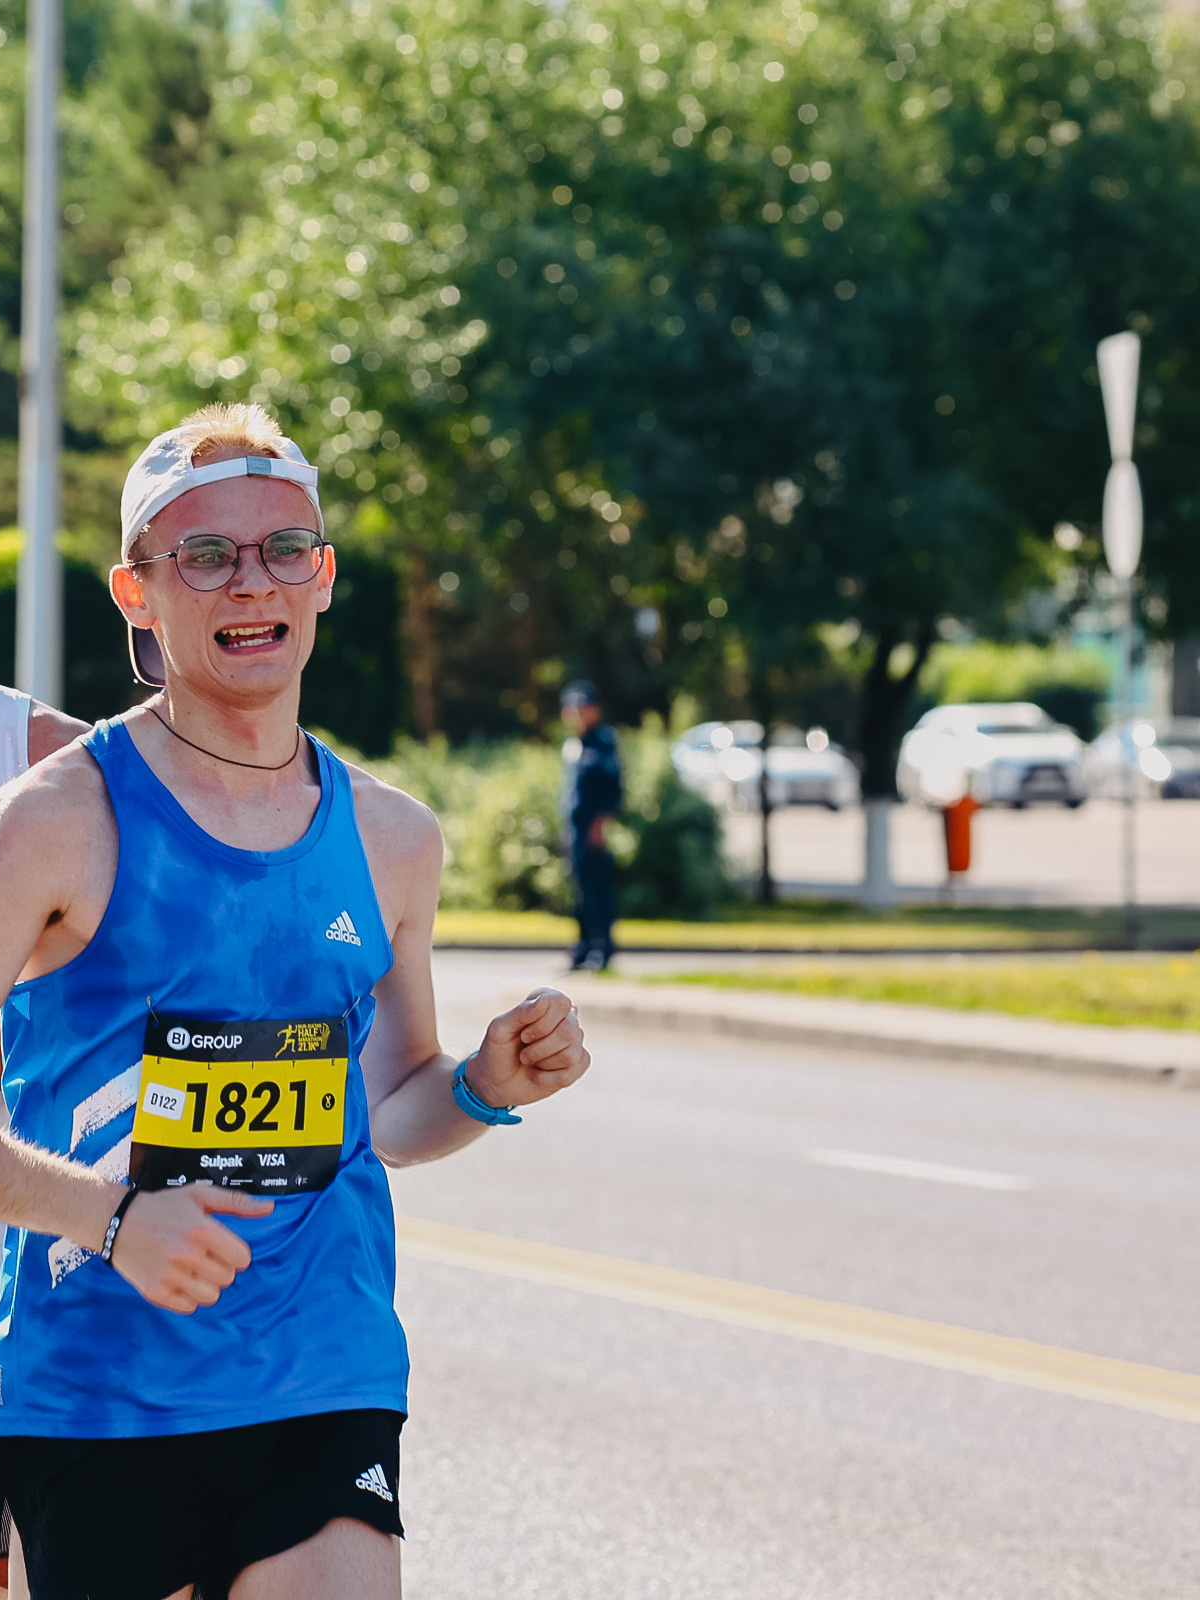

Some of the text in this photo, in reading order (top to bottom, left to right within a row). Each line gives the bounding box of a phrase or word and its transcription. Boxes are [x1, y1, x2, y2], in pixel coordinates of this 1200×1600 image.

[326, 929, 361, 946] adidas
[298, 1028, 318, 1037] HALF
[191, 1034, 243, 1050] GROUP
[150, 1092, 177, 1111] D122
[186, 1080, 307, 1133] 1821
[200, 1153, 286, 1170] Sulpak VISA
[355, 1478, 393, 1502] adidas
